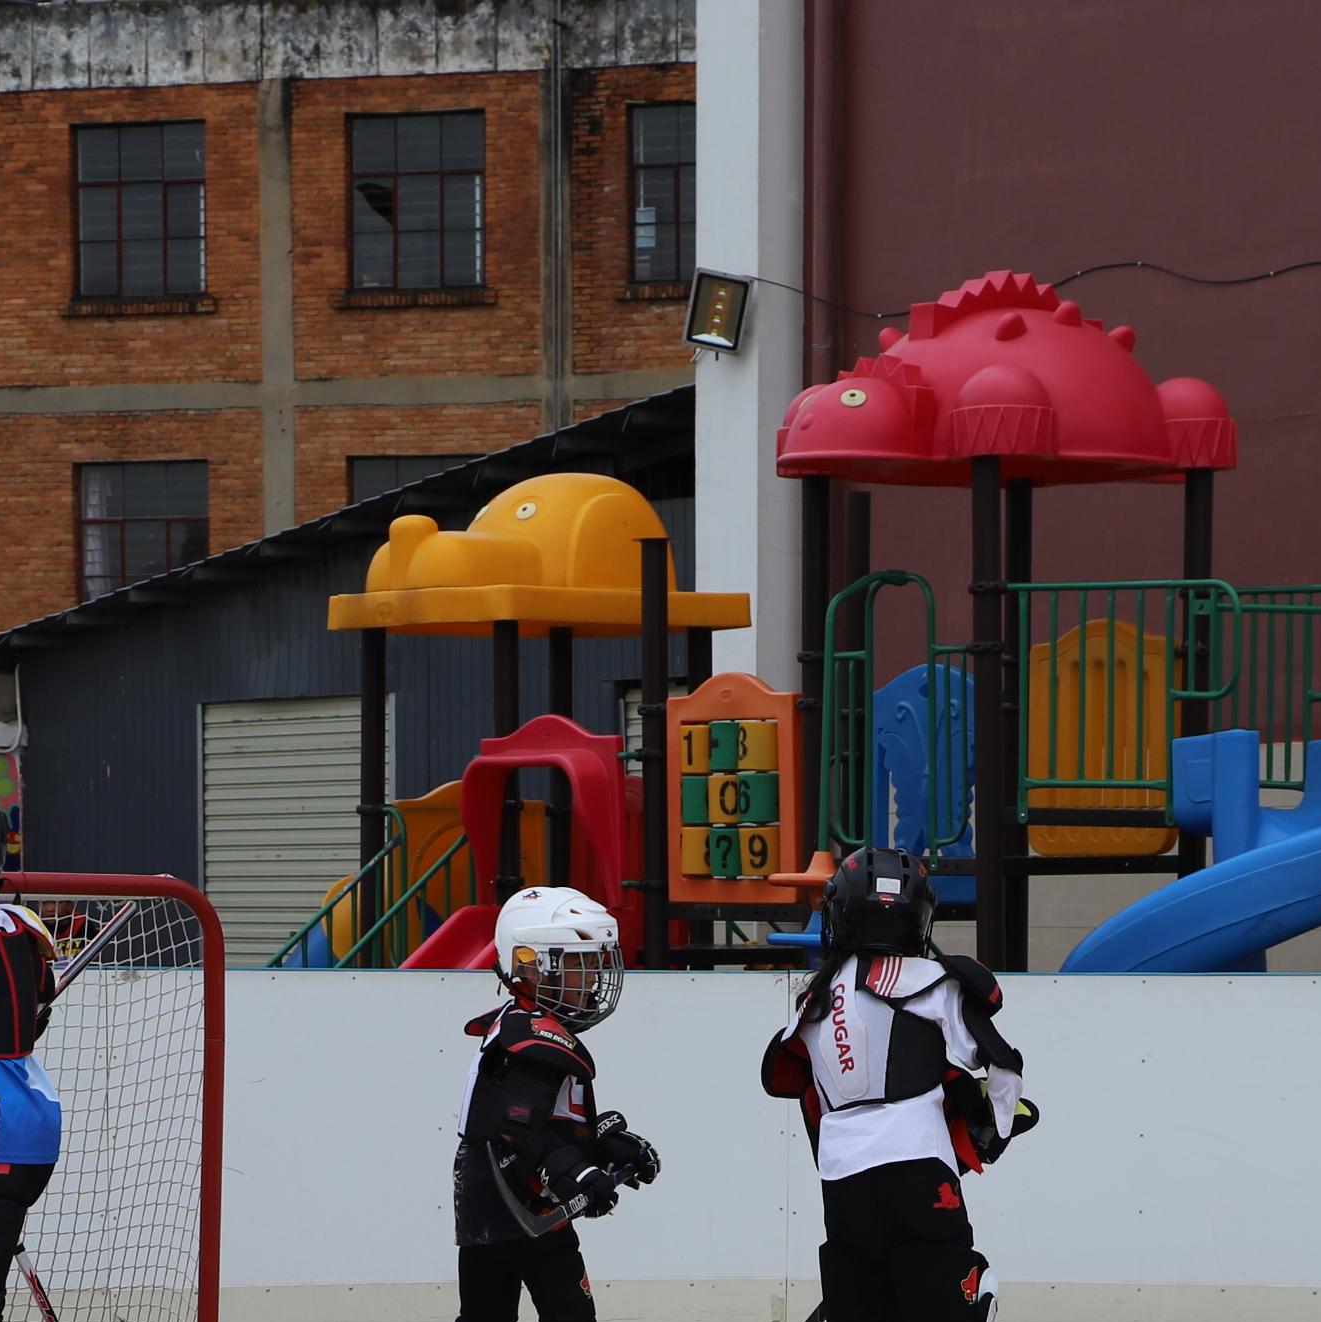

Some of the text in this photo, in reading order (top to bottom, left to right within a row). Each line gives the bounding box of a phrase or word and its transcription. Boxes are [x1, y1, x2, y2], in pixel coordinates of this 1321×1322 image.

[748, 834, 768, 869] 9
[539, 1030, 574, 1050] RED DEVILS
[830, 983, 855, 1074] COUGAR
